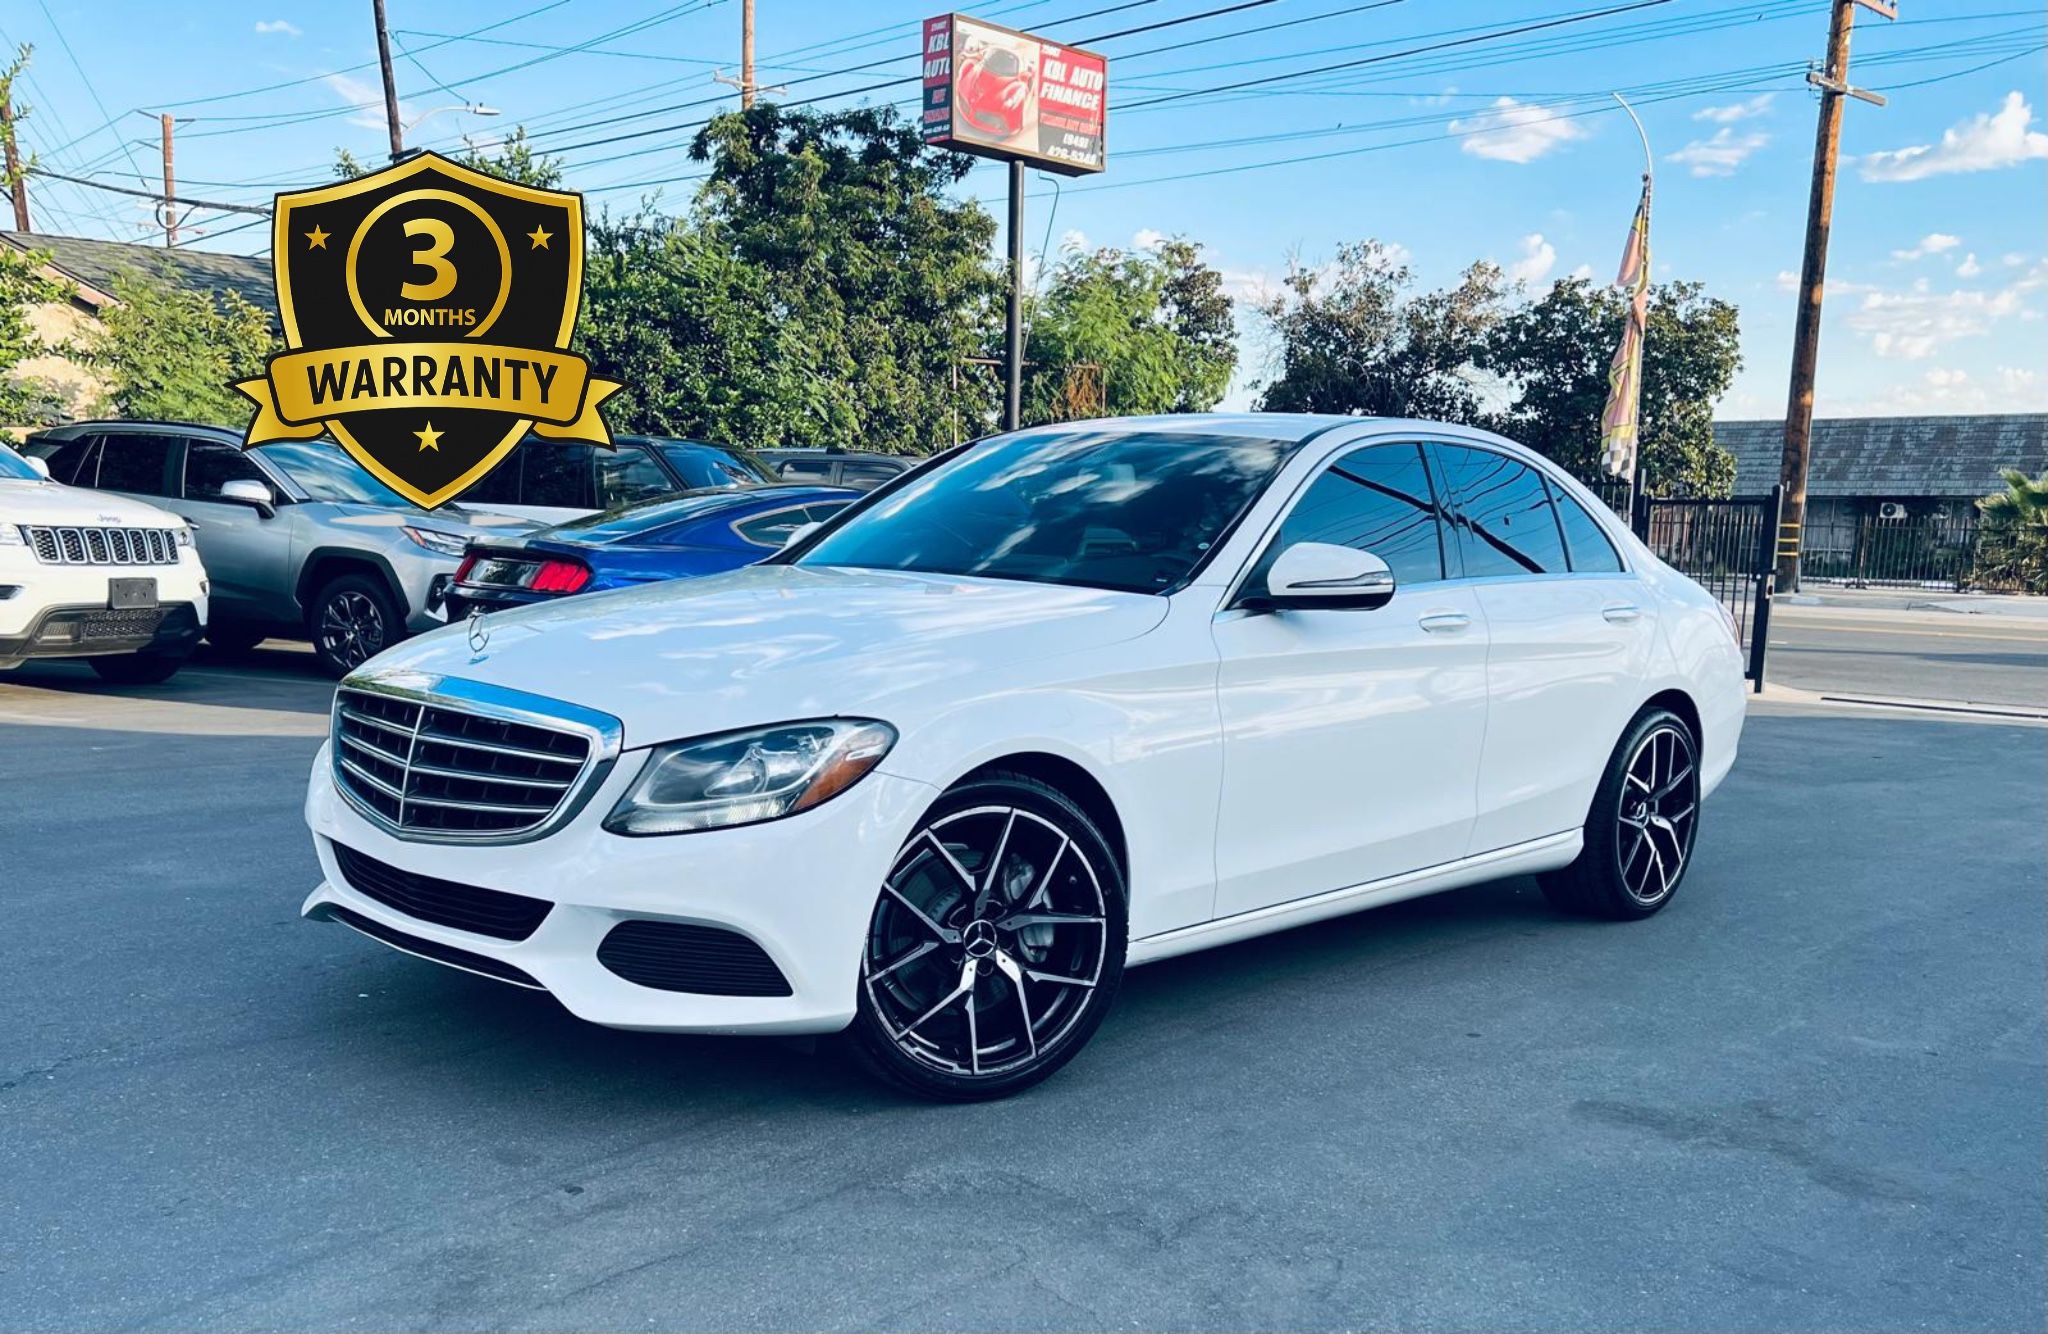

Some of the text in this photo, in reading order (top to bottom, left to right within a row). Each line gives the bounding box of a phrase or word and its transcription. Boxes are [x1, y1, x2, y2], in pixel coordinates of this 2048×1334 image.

[927, 31, 950, 53] KBL
[1042, 58, 1104, 91] KBL AUTO
[1040, 81, 1100, 110] FINANCE
